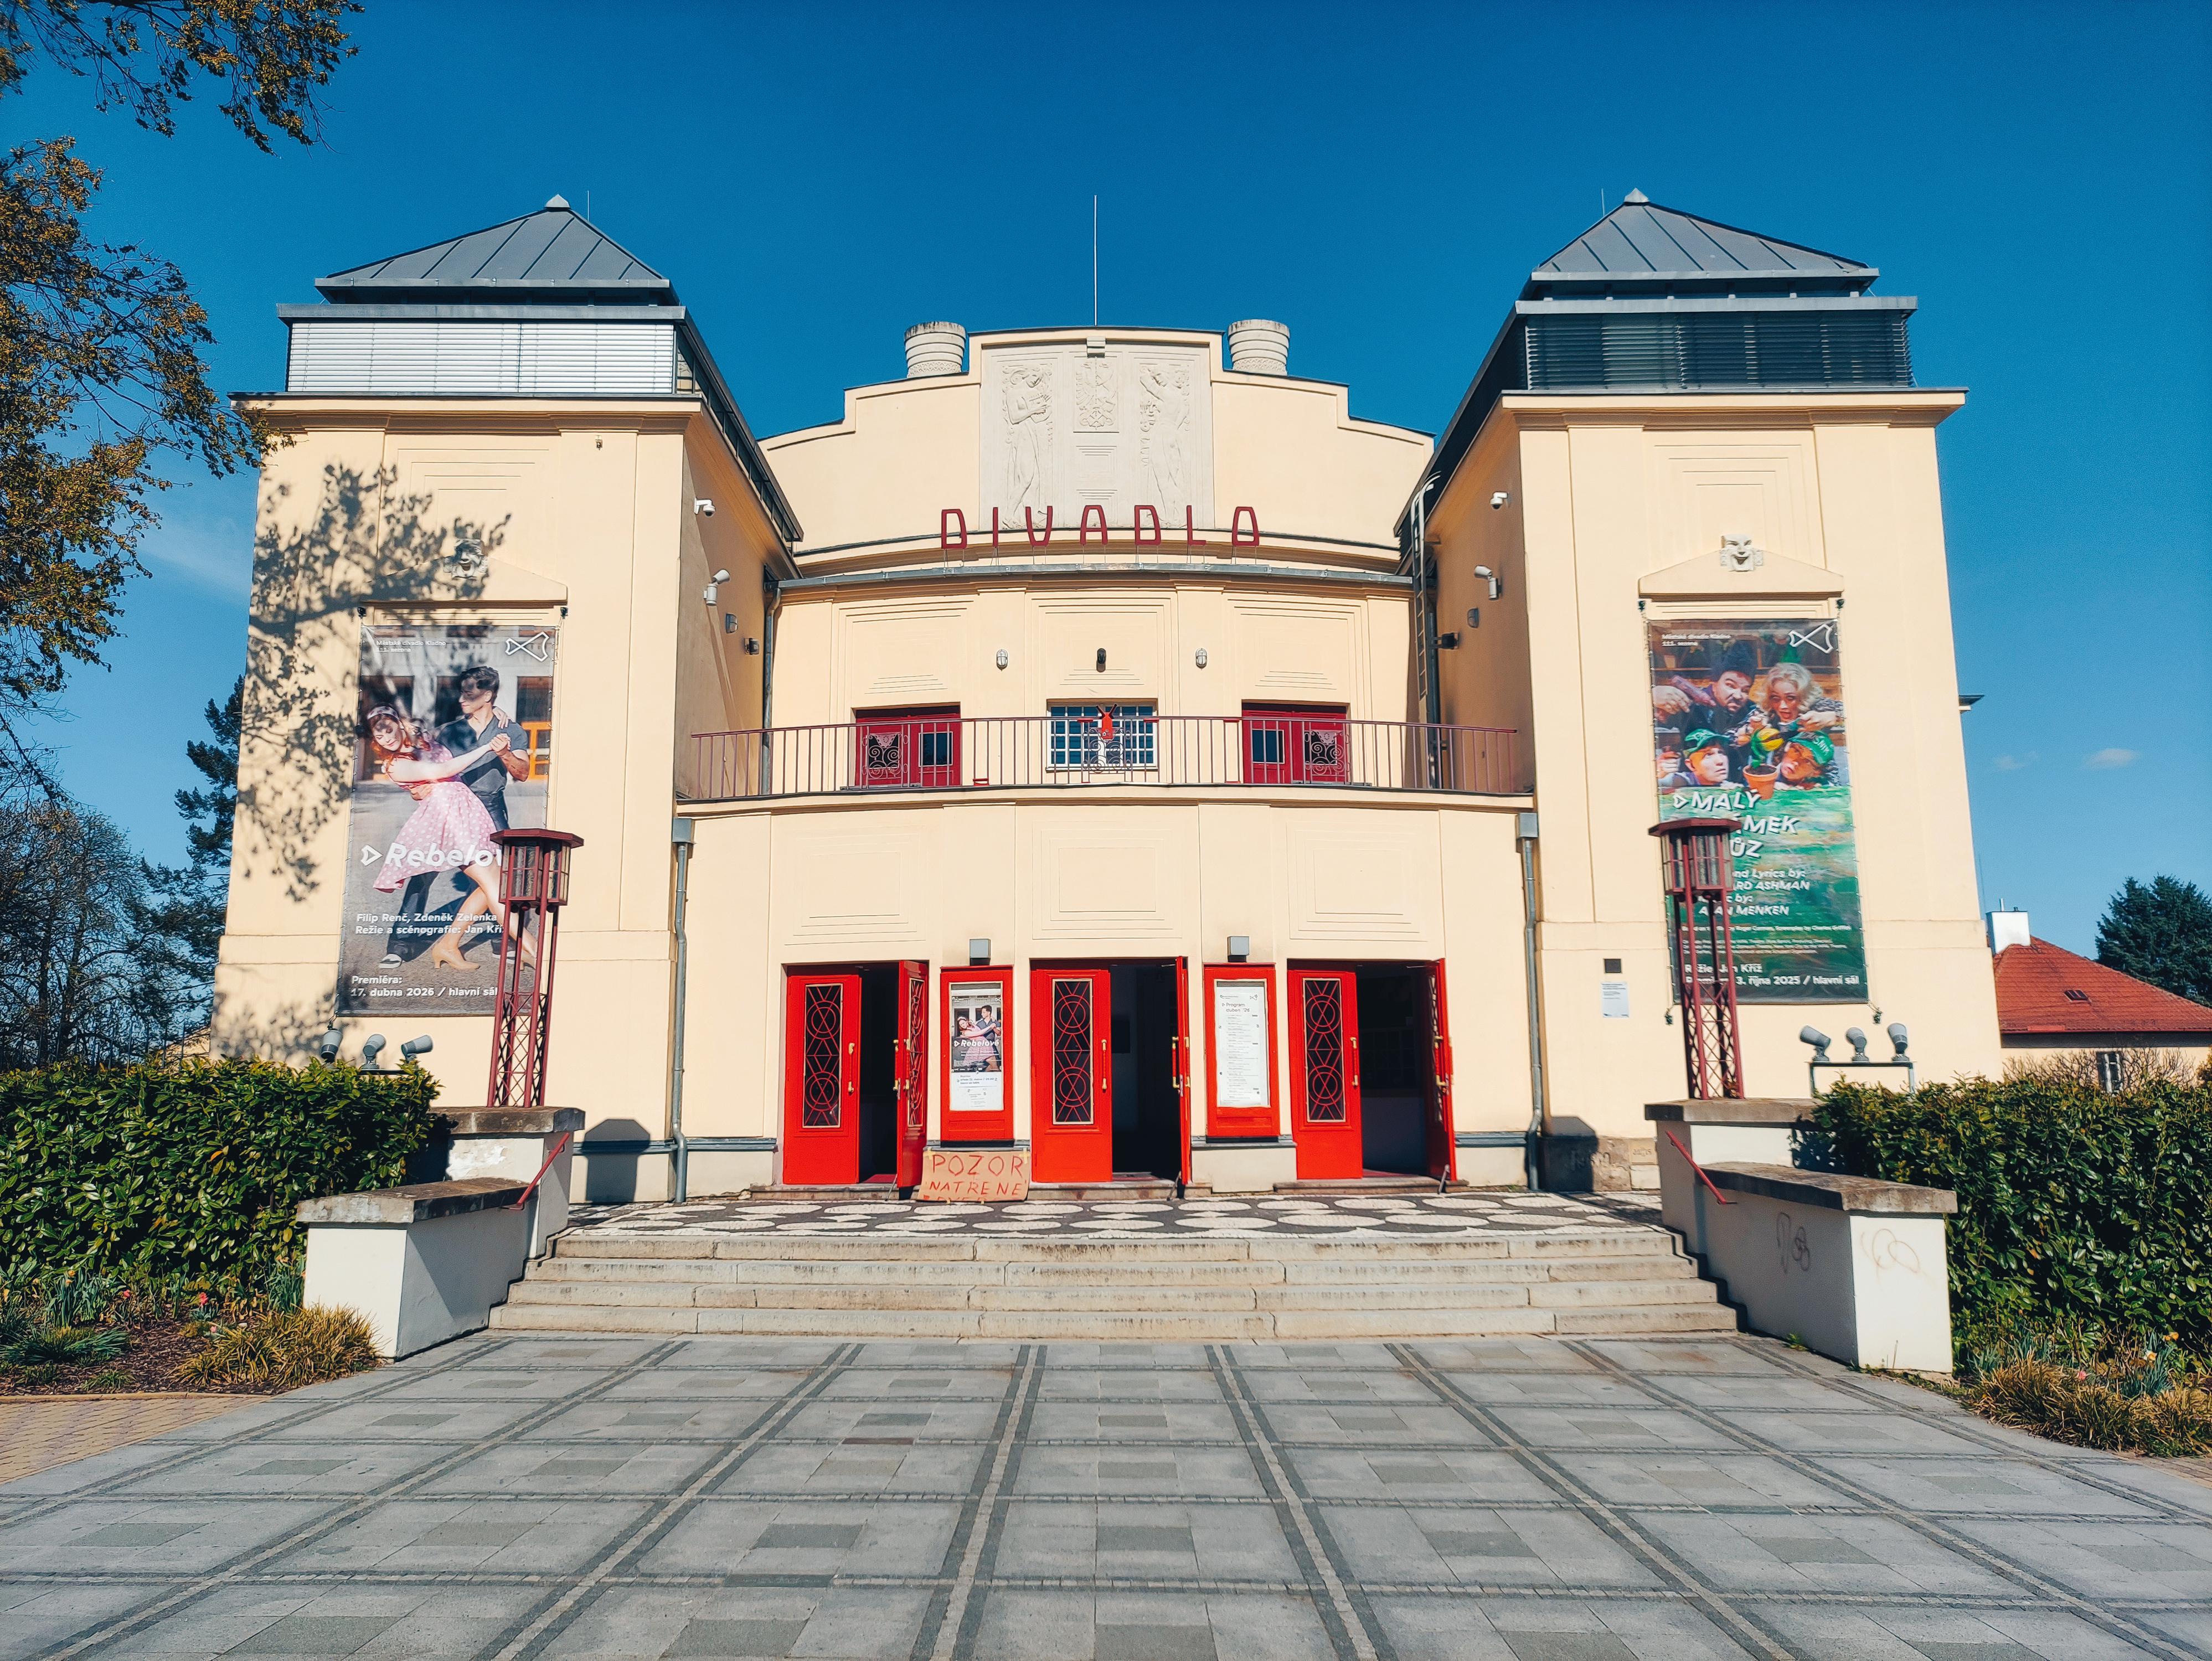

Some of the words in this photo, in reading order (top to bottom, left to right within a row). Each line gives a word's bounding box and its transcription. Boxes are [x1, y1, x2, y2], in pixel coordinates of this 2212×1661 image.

[941, 505, 1260, 549] DIVADLO
[1691, 789, 1761, 811] MALÝ
[1733, 812, 1801, 835] MEK
[1730, 836, 1764, 858] ŮZ
[385, 842, 502, 868] Rebelo
[1733, 869, 1749, 878] nd
[1736, 904, 1790, 916] MENKEN
[356, 913, 379, 924] Filip
[381, 913, 411, 924] Renč,
[414, 912, 453, 922] Zdeněk
[457, 913, 497, 922] Zelenka
[355, 925, 384, 934] Režie
[396, 925, 461, 935] scénografie:
[464, 925, 483, 933] Jan
[487, 925, 504, 934] Kří
[352, 975, 403, 984] Premiéra:
[1735, 976, 1746, 985] 3.
[1773, 976, 1801, 985] 2025
[1803, 975, 1811, 985] /
[1812, 974, 1843, 985] hlavní
[1844, 974, 1859, 984] sál
[350, 988, 367, 997] 17.
[369, 988, 403, 997] dubna
[406, 987, 435, 997] 2026
[437, 987, 446, 997] /
[448, 987, 480, 997] hlavní
[483, 987, 498, 996] sál
[961, 1039, 999, 1048] Rebelové
[932, 1154, 1023, 1178] POZOR
